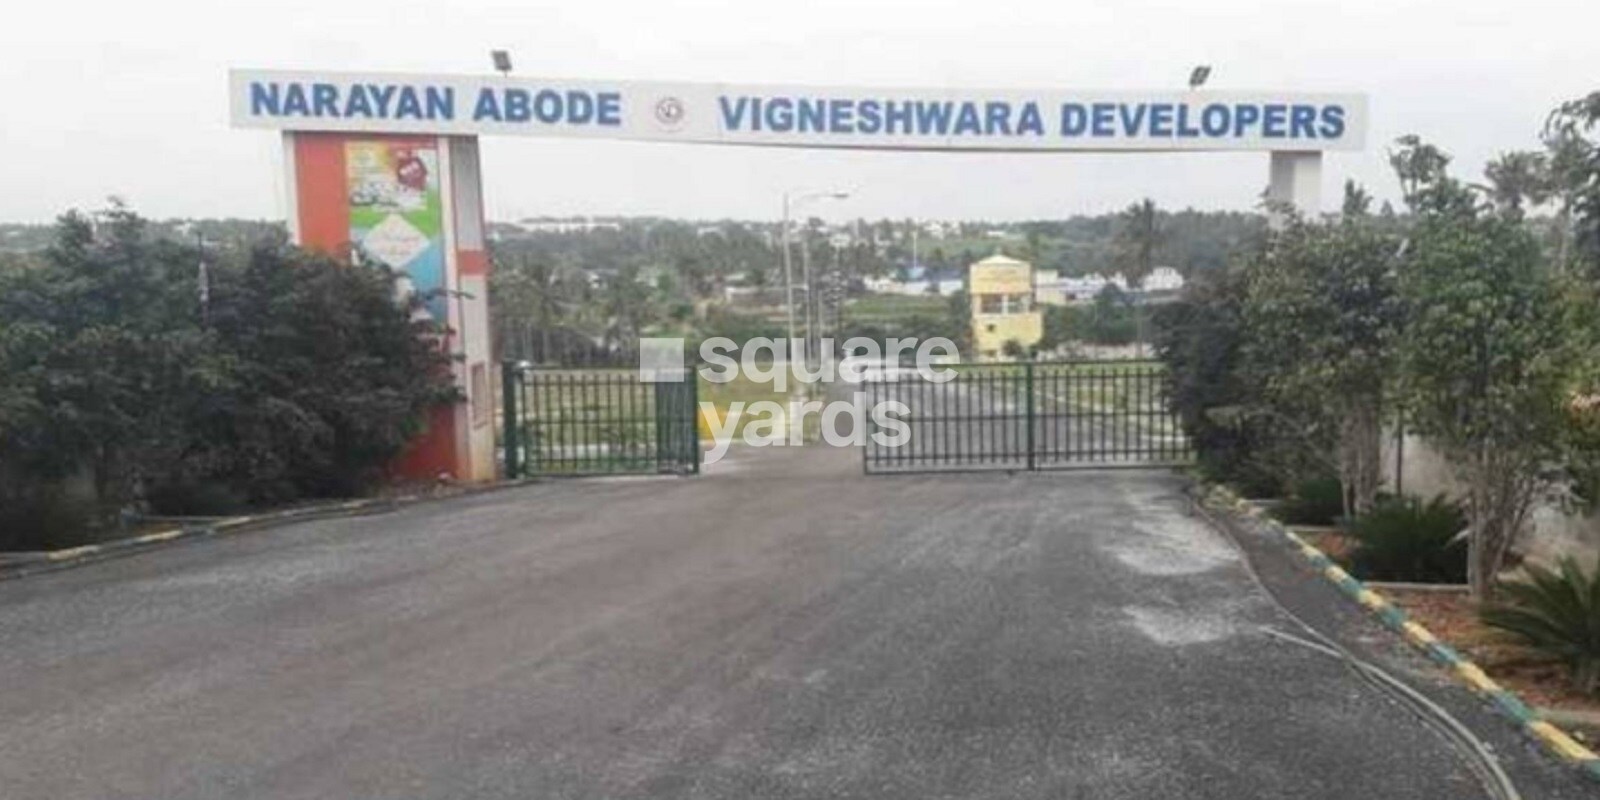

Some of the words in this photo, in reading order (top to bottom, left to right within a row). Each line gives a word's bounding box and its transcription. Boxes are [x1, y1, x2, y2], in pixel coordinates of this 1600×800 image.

[249, 82, 455, 121] NARAYAN
[472, 88, 622, 126] ABODE
[719, 95, 1046, 138] VIGNESHWARA
[1060, 102, 1346, 140] DEVELOPERS
